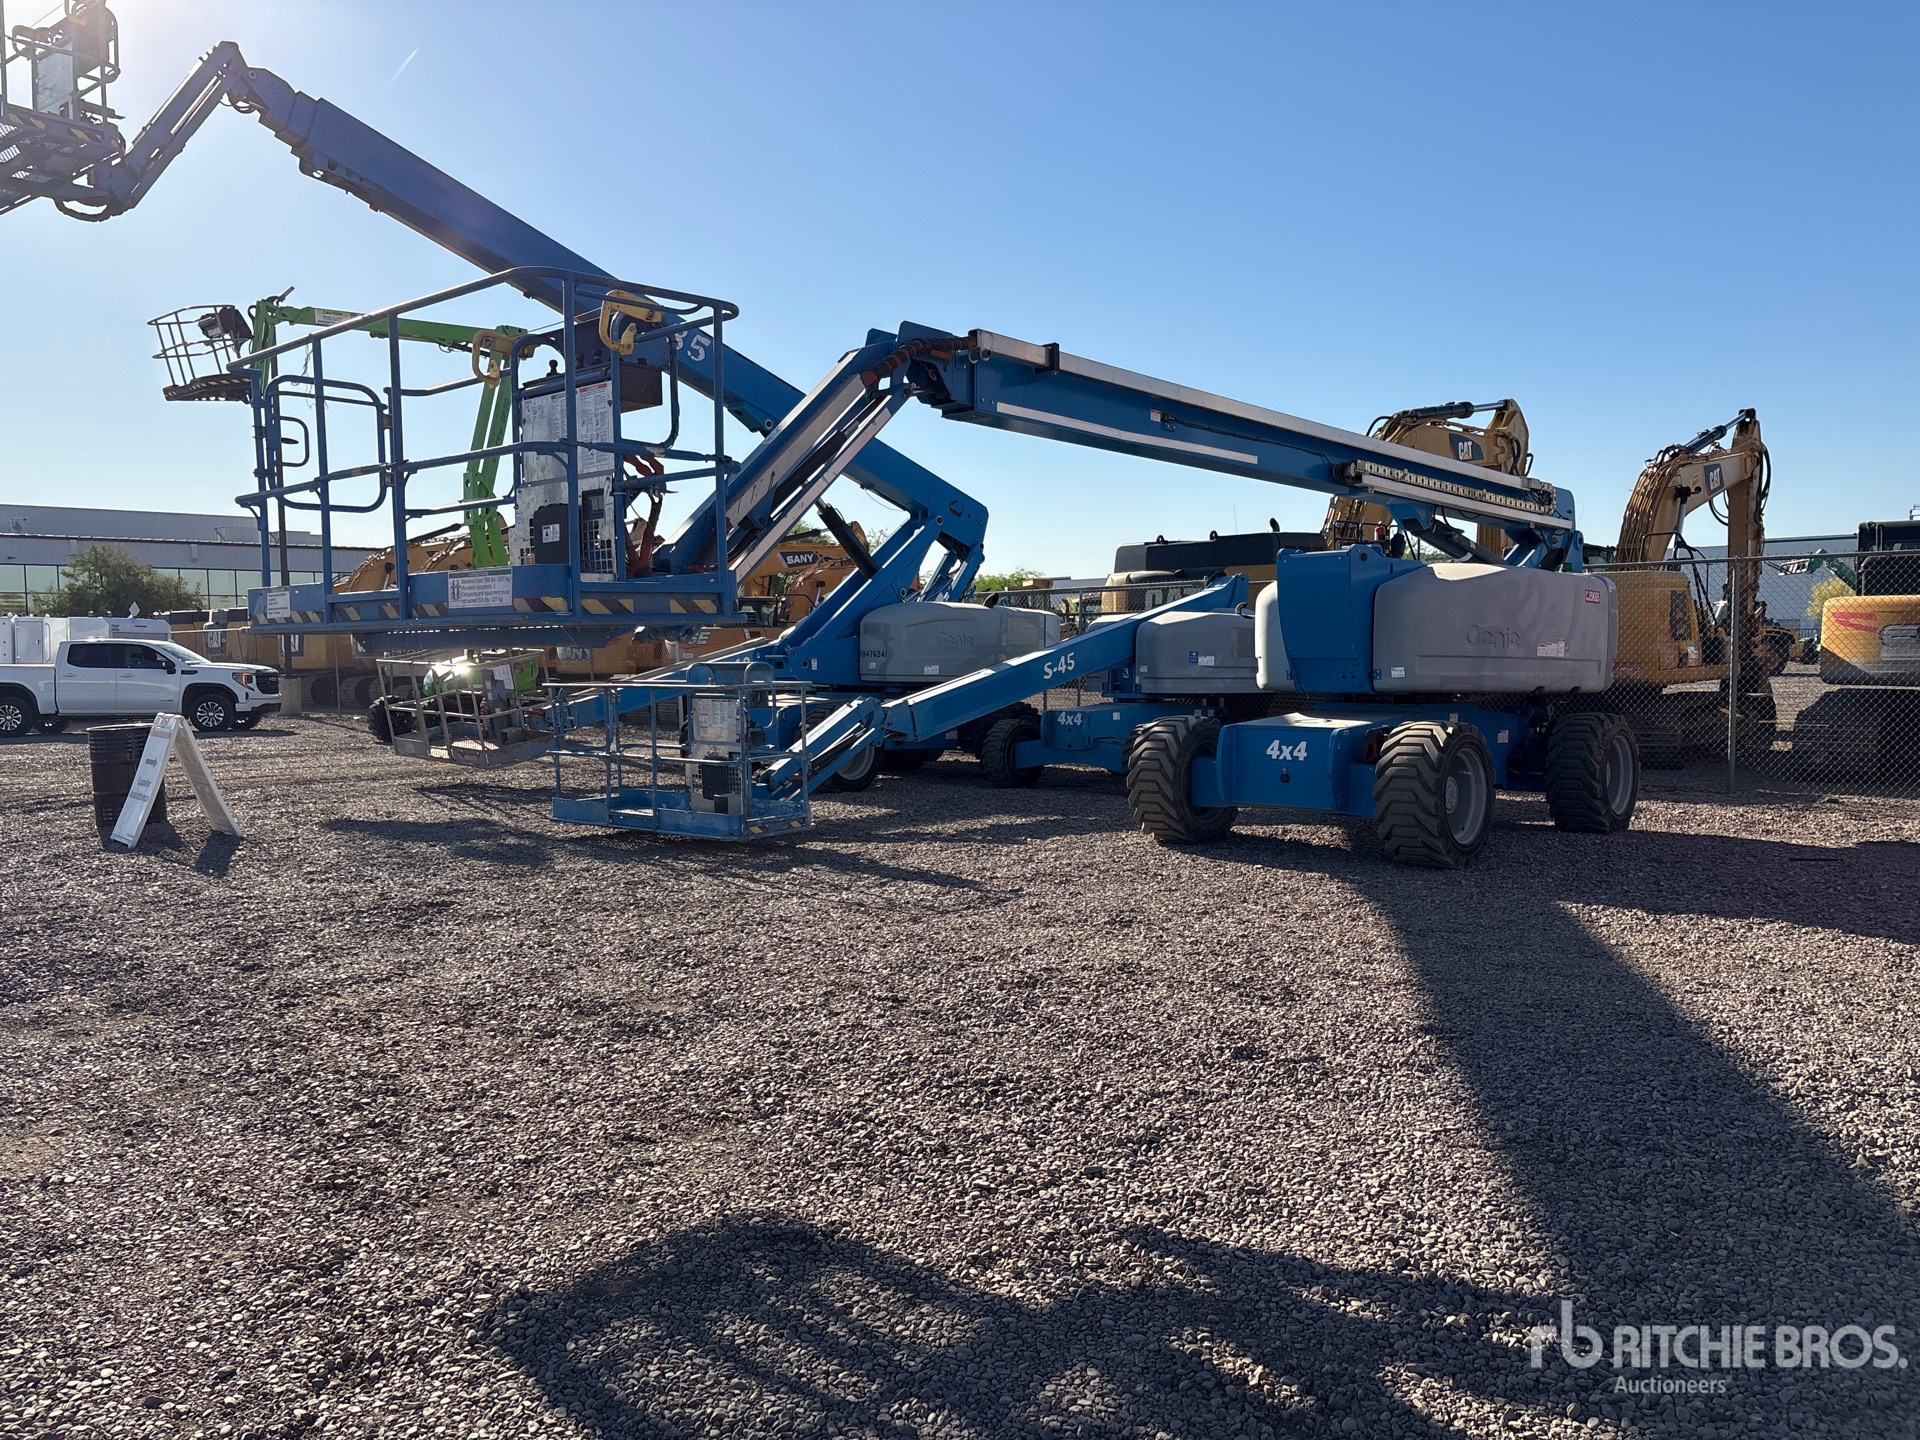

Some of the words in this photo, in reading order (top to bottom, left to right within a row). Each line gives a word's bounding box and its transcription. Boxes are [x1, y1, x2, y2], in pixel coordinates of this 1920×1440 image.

[1458, 441, 1473, 460] CAT
[1709, 467, 1721, 490] CAT
[786, 553, 814, 565] SANY
[937, 631, 974, 648] Genie
[1465, 624, 1520, 649] Genie
[1043, 651, 1076, 680] S-45
[1057, 711, 1083, 726] 4x4
[1265, 739, 1308, 761] 4x4
